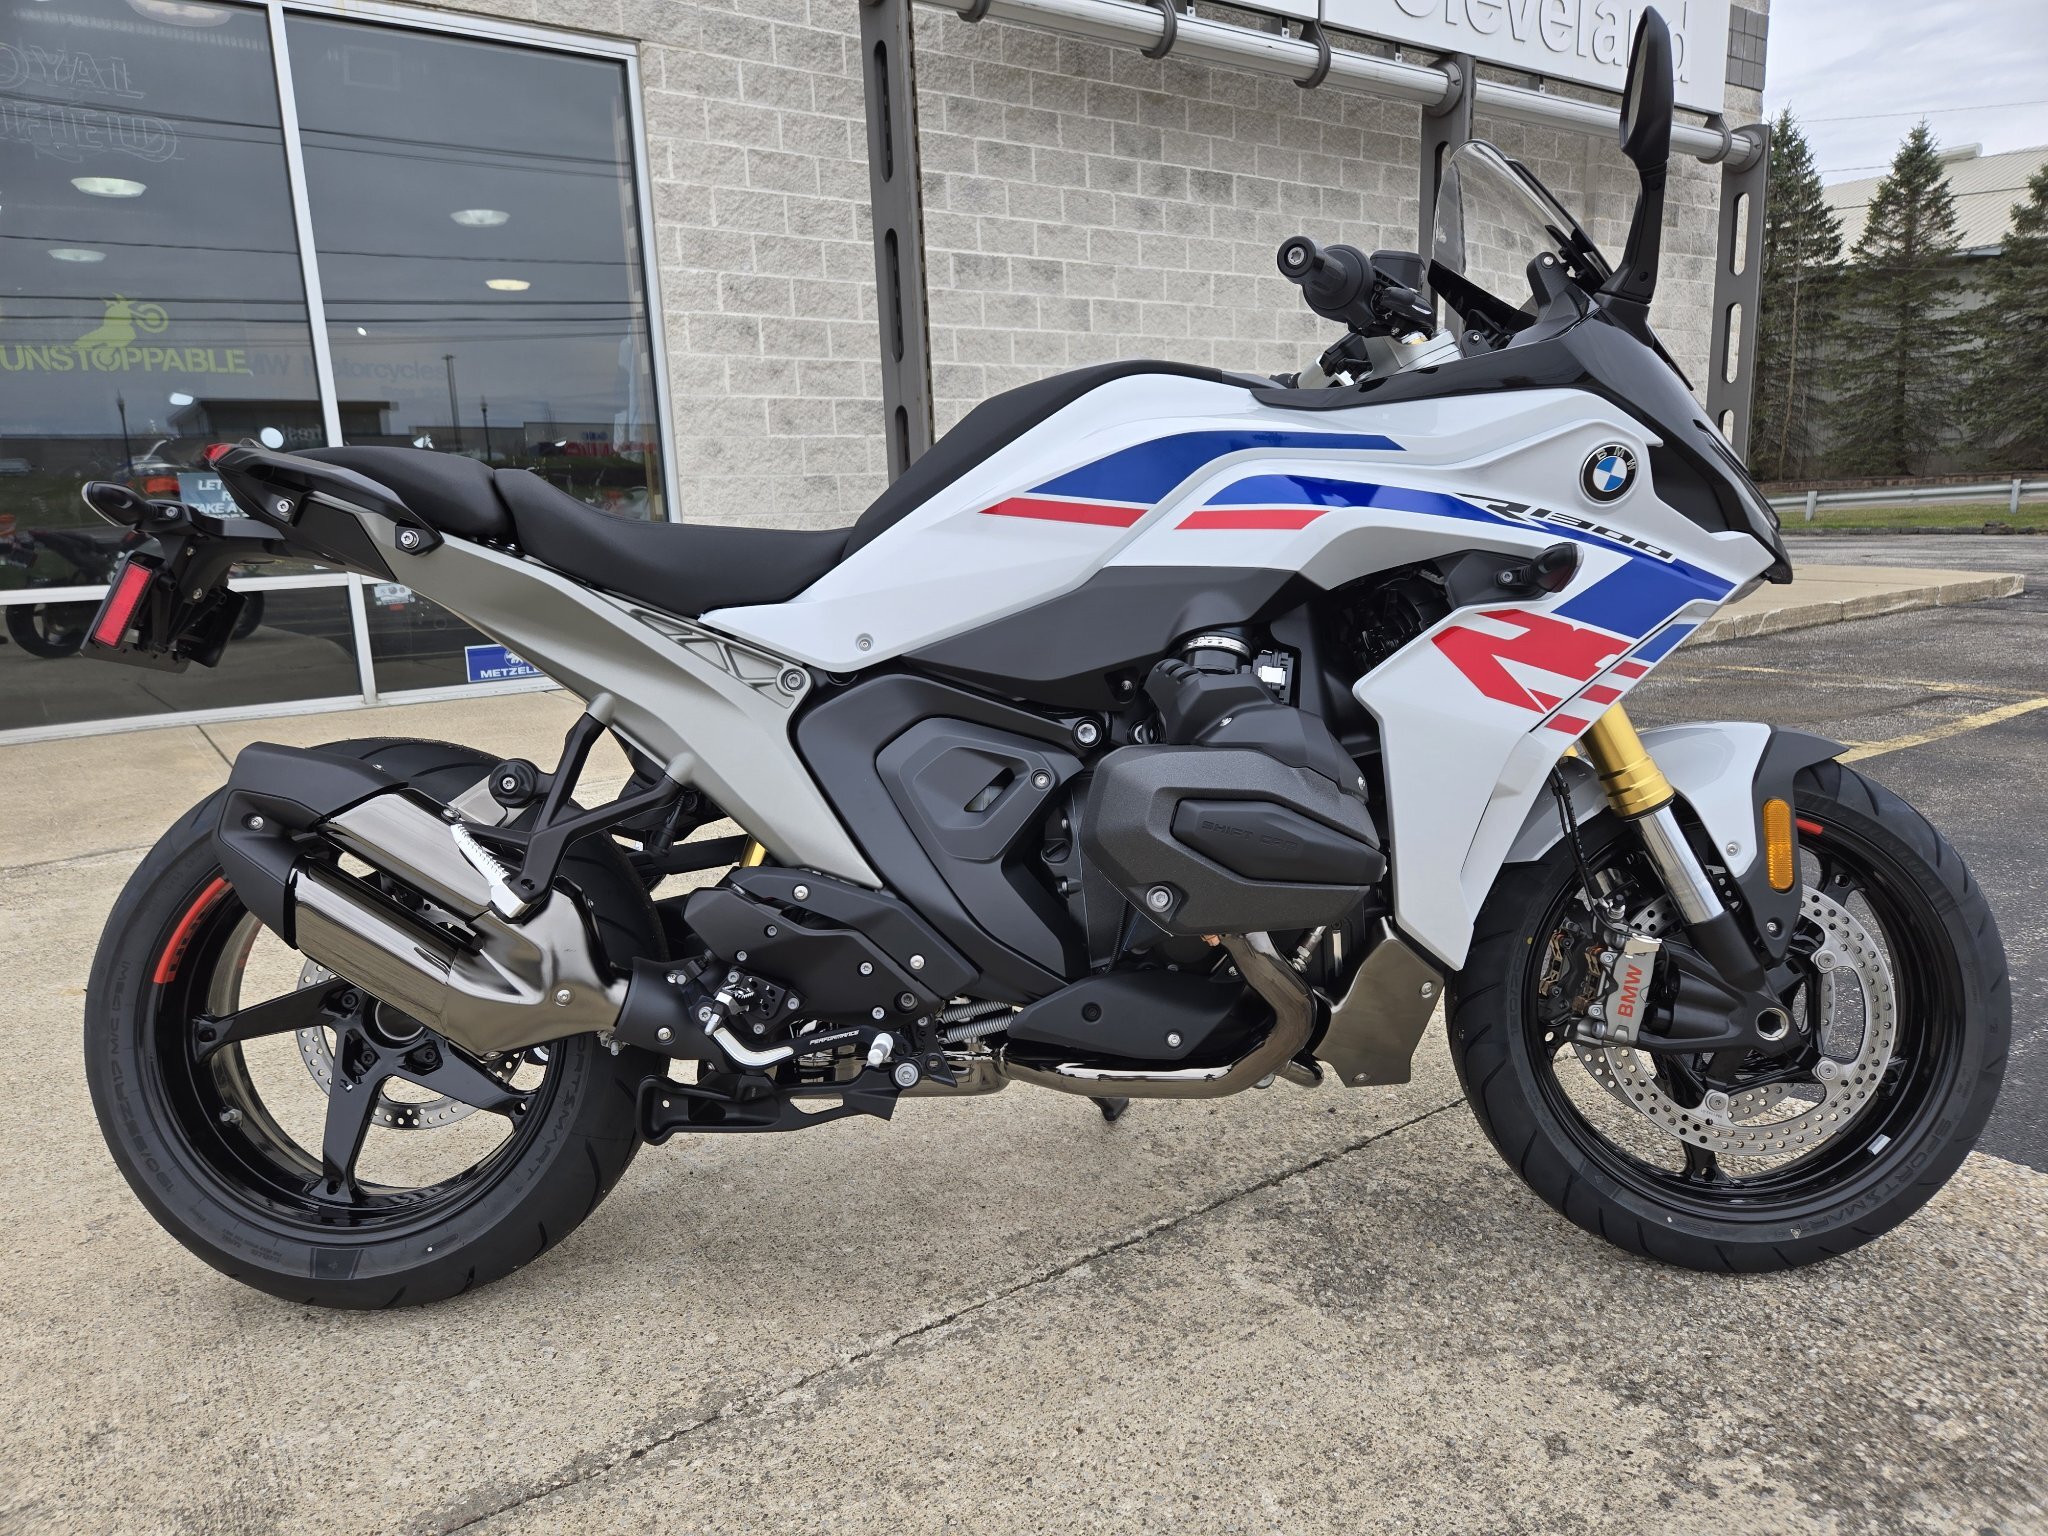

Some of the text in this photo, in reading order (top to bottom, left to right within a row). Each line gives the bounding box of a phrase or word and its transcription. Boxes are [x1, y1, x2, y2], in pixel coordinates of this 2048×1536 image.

[1392, 0, 1689, 84] evelad
[0, 42, 145, 99] OYAL
[0, 345, 250, 374] UNSTOPPABLE
[303, 354, 449, 385] torcycles
[1596, 445, 1636, 472] BMW
[1201, 820, 1254, 840] SHIFT
[1617, 963, 1643, 1018] BMW
[809, 1029, 860, 1046] PERFORMANCE
